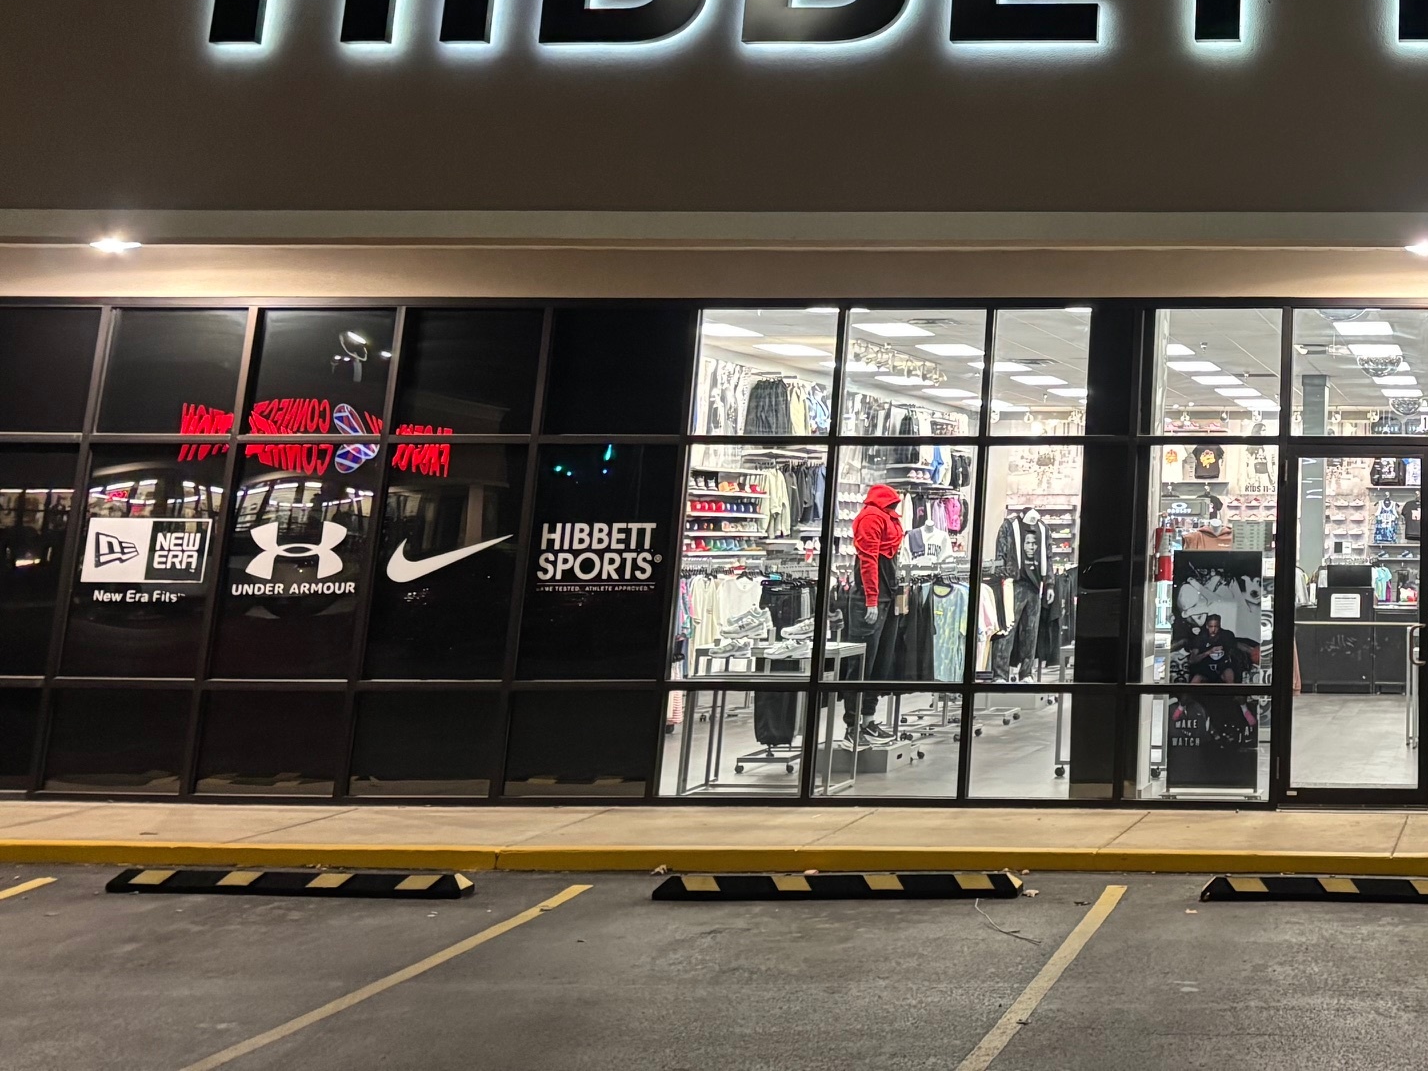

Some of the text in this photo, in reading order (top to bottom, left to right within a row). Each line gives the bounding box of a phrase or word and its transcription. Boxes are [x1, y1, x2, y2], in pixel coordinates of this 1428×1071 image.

[1244, 484, 1261, 493] KIDS
[155, 532, 201, 551] NEW
[540, 522, 657, 550] HIBBETT
[153, 551, 198, 570] ERA
[93, 589, 123, 603] New
[126, 590, 149, 603] Era
[231, 582, 356, 596] UNDER ARMOUR
[1175, 719, 1198, 729] MAKE
[1172, 737, 1200, 747] WATCH
